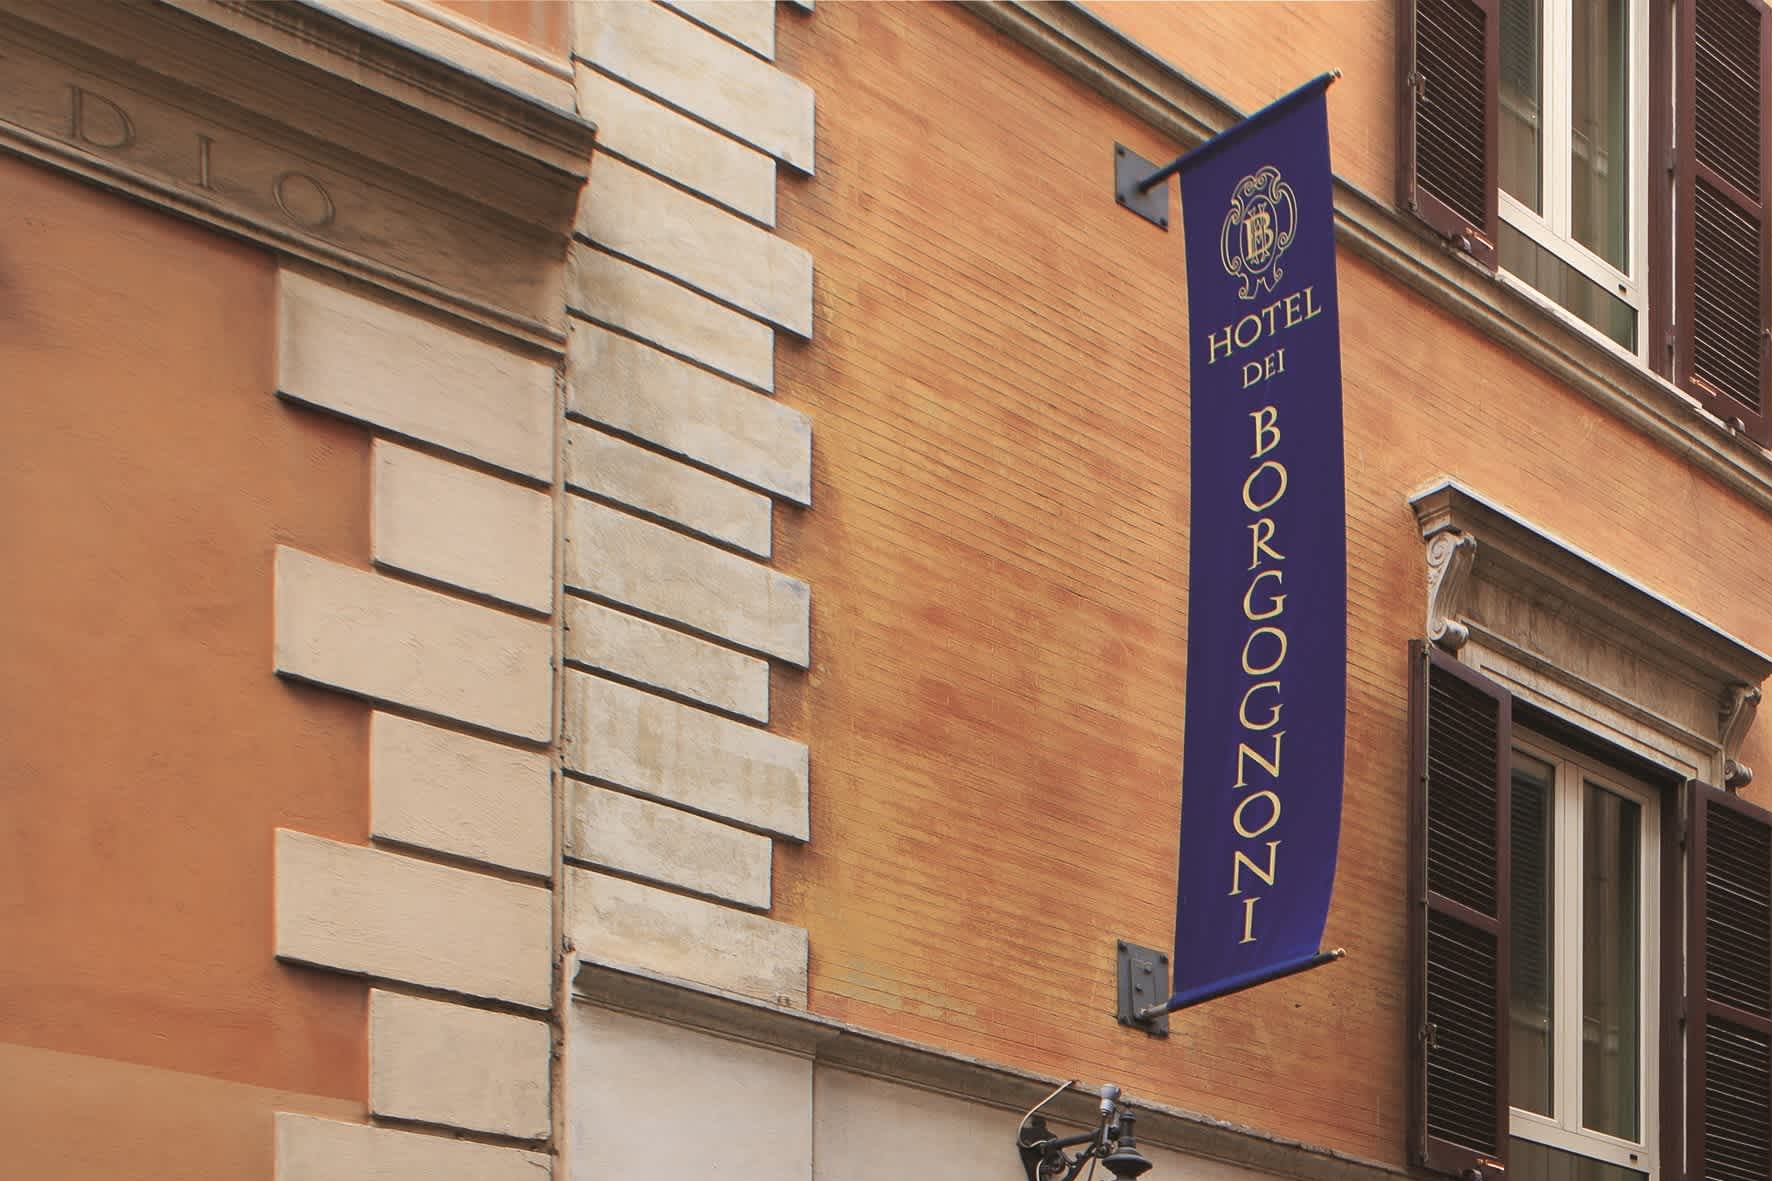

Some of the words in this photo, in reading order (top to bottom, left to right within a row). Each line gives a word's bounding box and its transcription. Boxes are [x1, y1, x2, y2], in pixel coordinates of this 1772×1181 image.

[1207, 285, 1322, 366] HOTEL
[1241, 348, 1286, 390] DEI
[1228, 405, 1288, 944] BORGOGNONI
